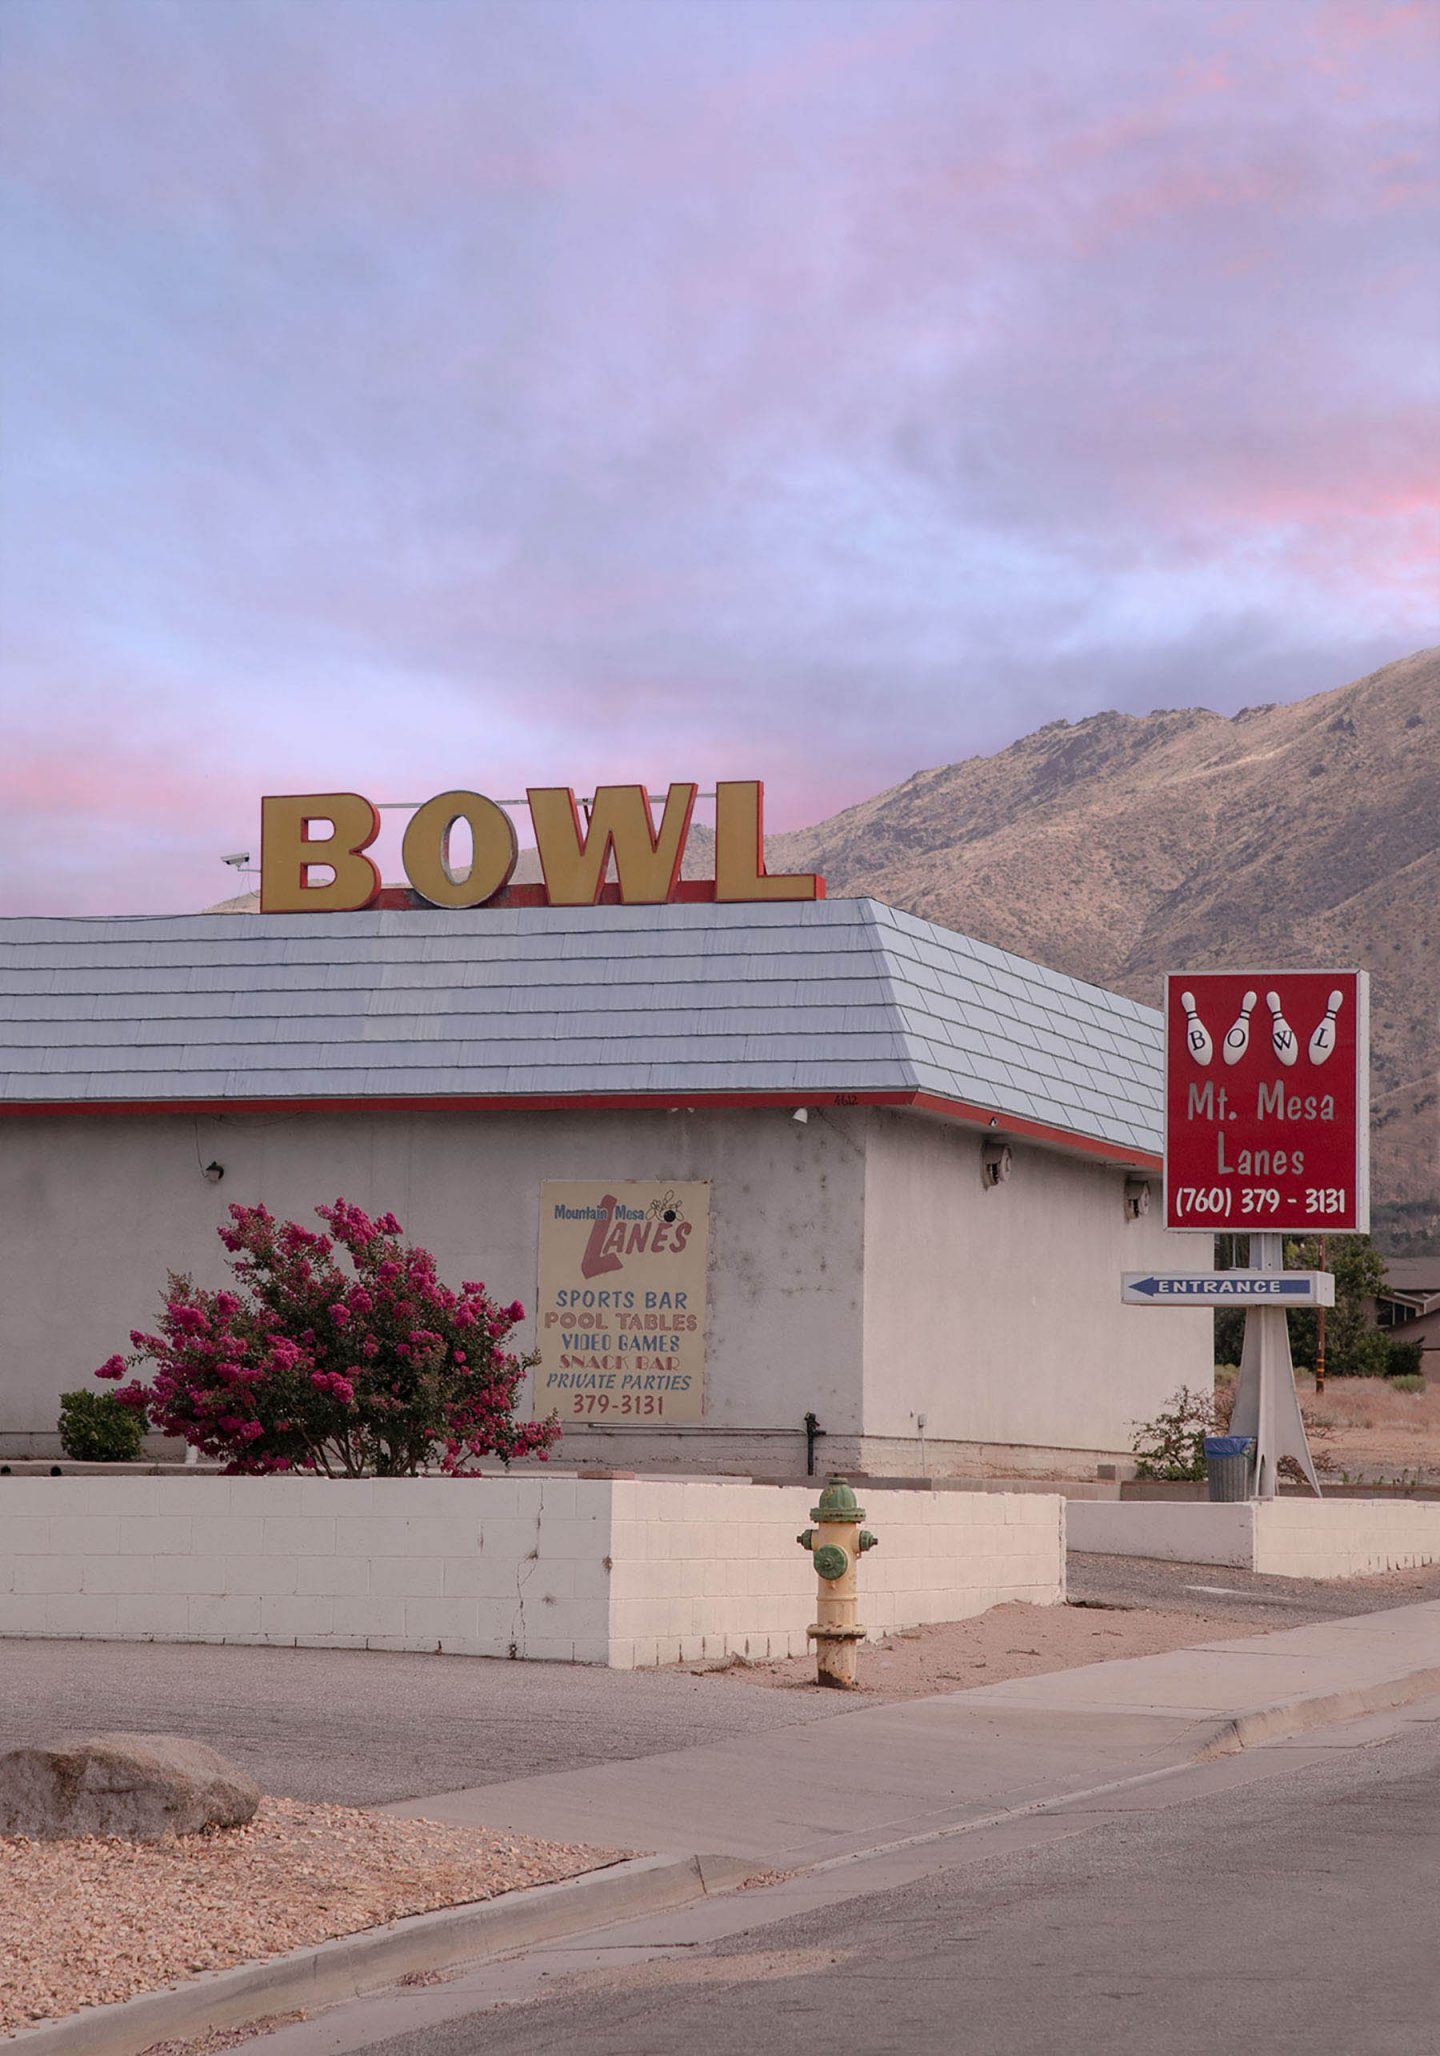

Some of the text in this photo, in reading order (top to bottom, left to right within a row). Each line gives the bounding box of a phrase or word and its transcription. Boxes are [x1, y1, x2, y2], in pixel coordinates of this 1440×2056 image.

[260, 780, 826, 913] BOWL
[1188, 1028, 1331, 1051] BOWL
[1187, 1079, 1335, 1121] Mt. Mesa
[1217, 1131, 1304, 1176] Lanes
[1176, 1187, 1232, 1217] (760)
[1241, 1188, 1280, 1213] 379
[1305, 1188, 1345, 1214] 3131
[554, 1204, 645, 1221] Mountain Mesa
[581, 1194, 692, 1279] LANES
[1158, 1280, 1281, 1293] ENTRANCE
[556, 1290, 688, 1309] SPORTS BAR
[544, 1312, 697, 1331] POOL TABLES
[561, 1333, 680, 1352] VIDEO GAMES
[559, 1354, 681, 1371] SNACK BAR
[546, 1373, 692, 1391] PRIVATE PARTIES
[573, 1394, 664, 1415] 379-3131
